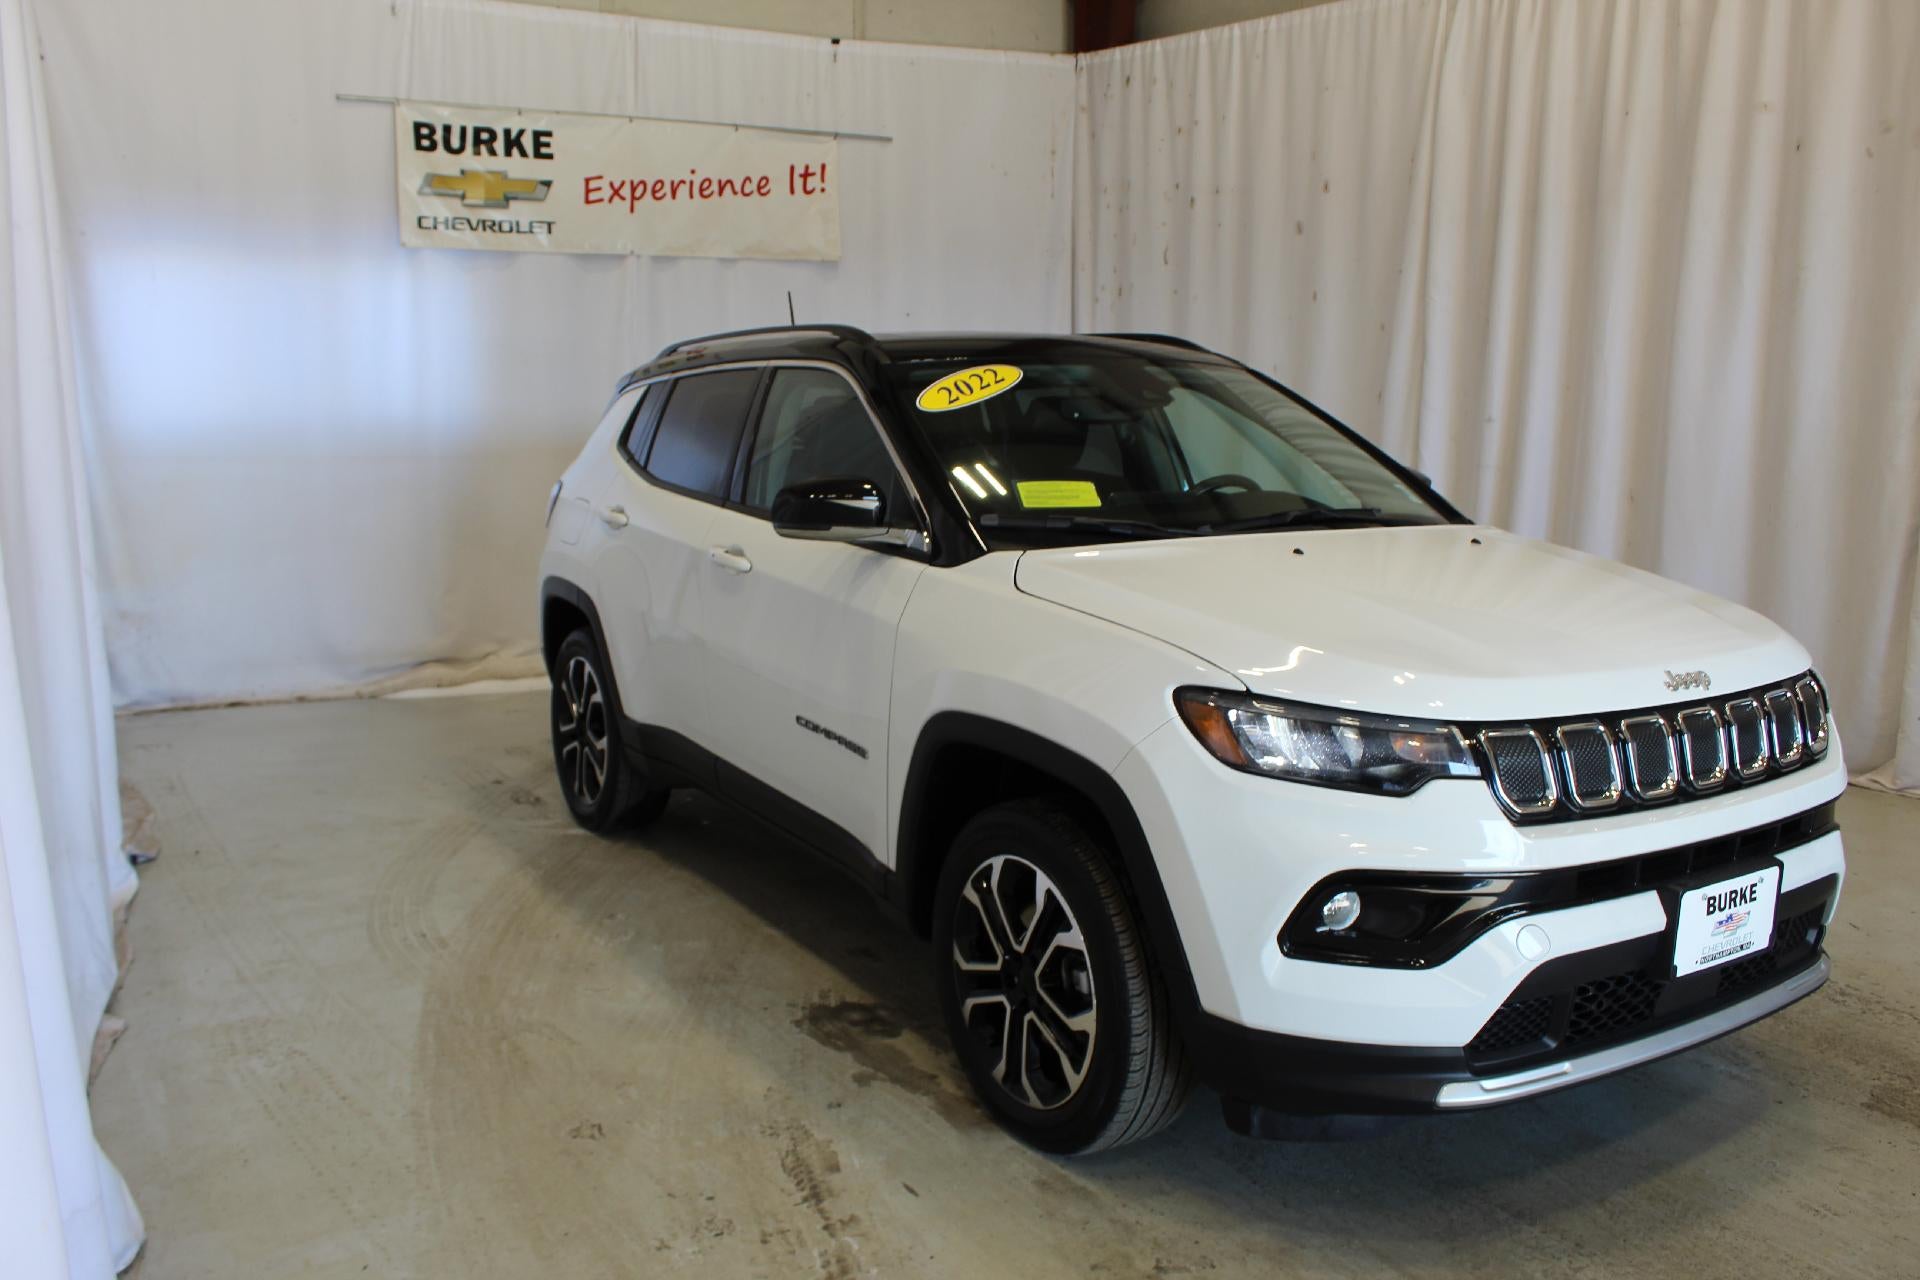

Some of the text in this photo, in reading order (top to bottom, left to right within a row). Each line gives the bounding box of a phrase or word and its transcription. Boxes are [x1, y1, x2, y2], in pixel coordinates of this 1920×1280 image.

[413, 121, 553, 160] BURKE
[584, 163, 827, 214] Experience It!
[417, 216, 556, 234] CHEVROLET
[937, 368, 1005, 404] 2022
[1663, 670, 1711, 691] Jeep
[795, 715, 868, 760] COMPASS
[1706, 883, 1758, 916] BURKE
[1702, 931, 1754, 955] CHEVROLET
